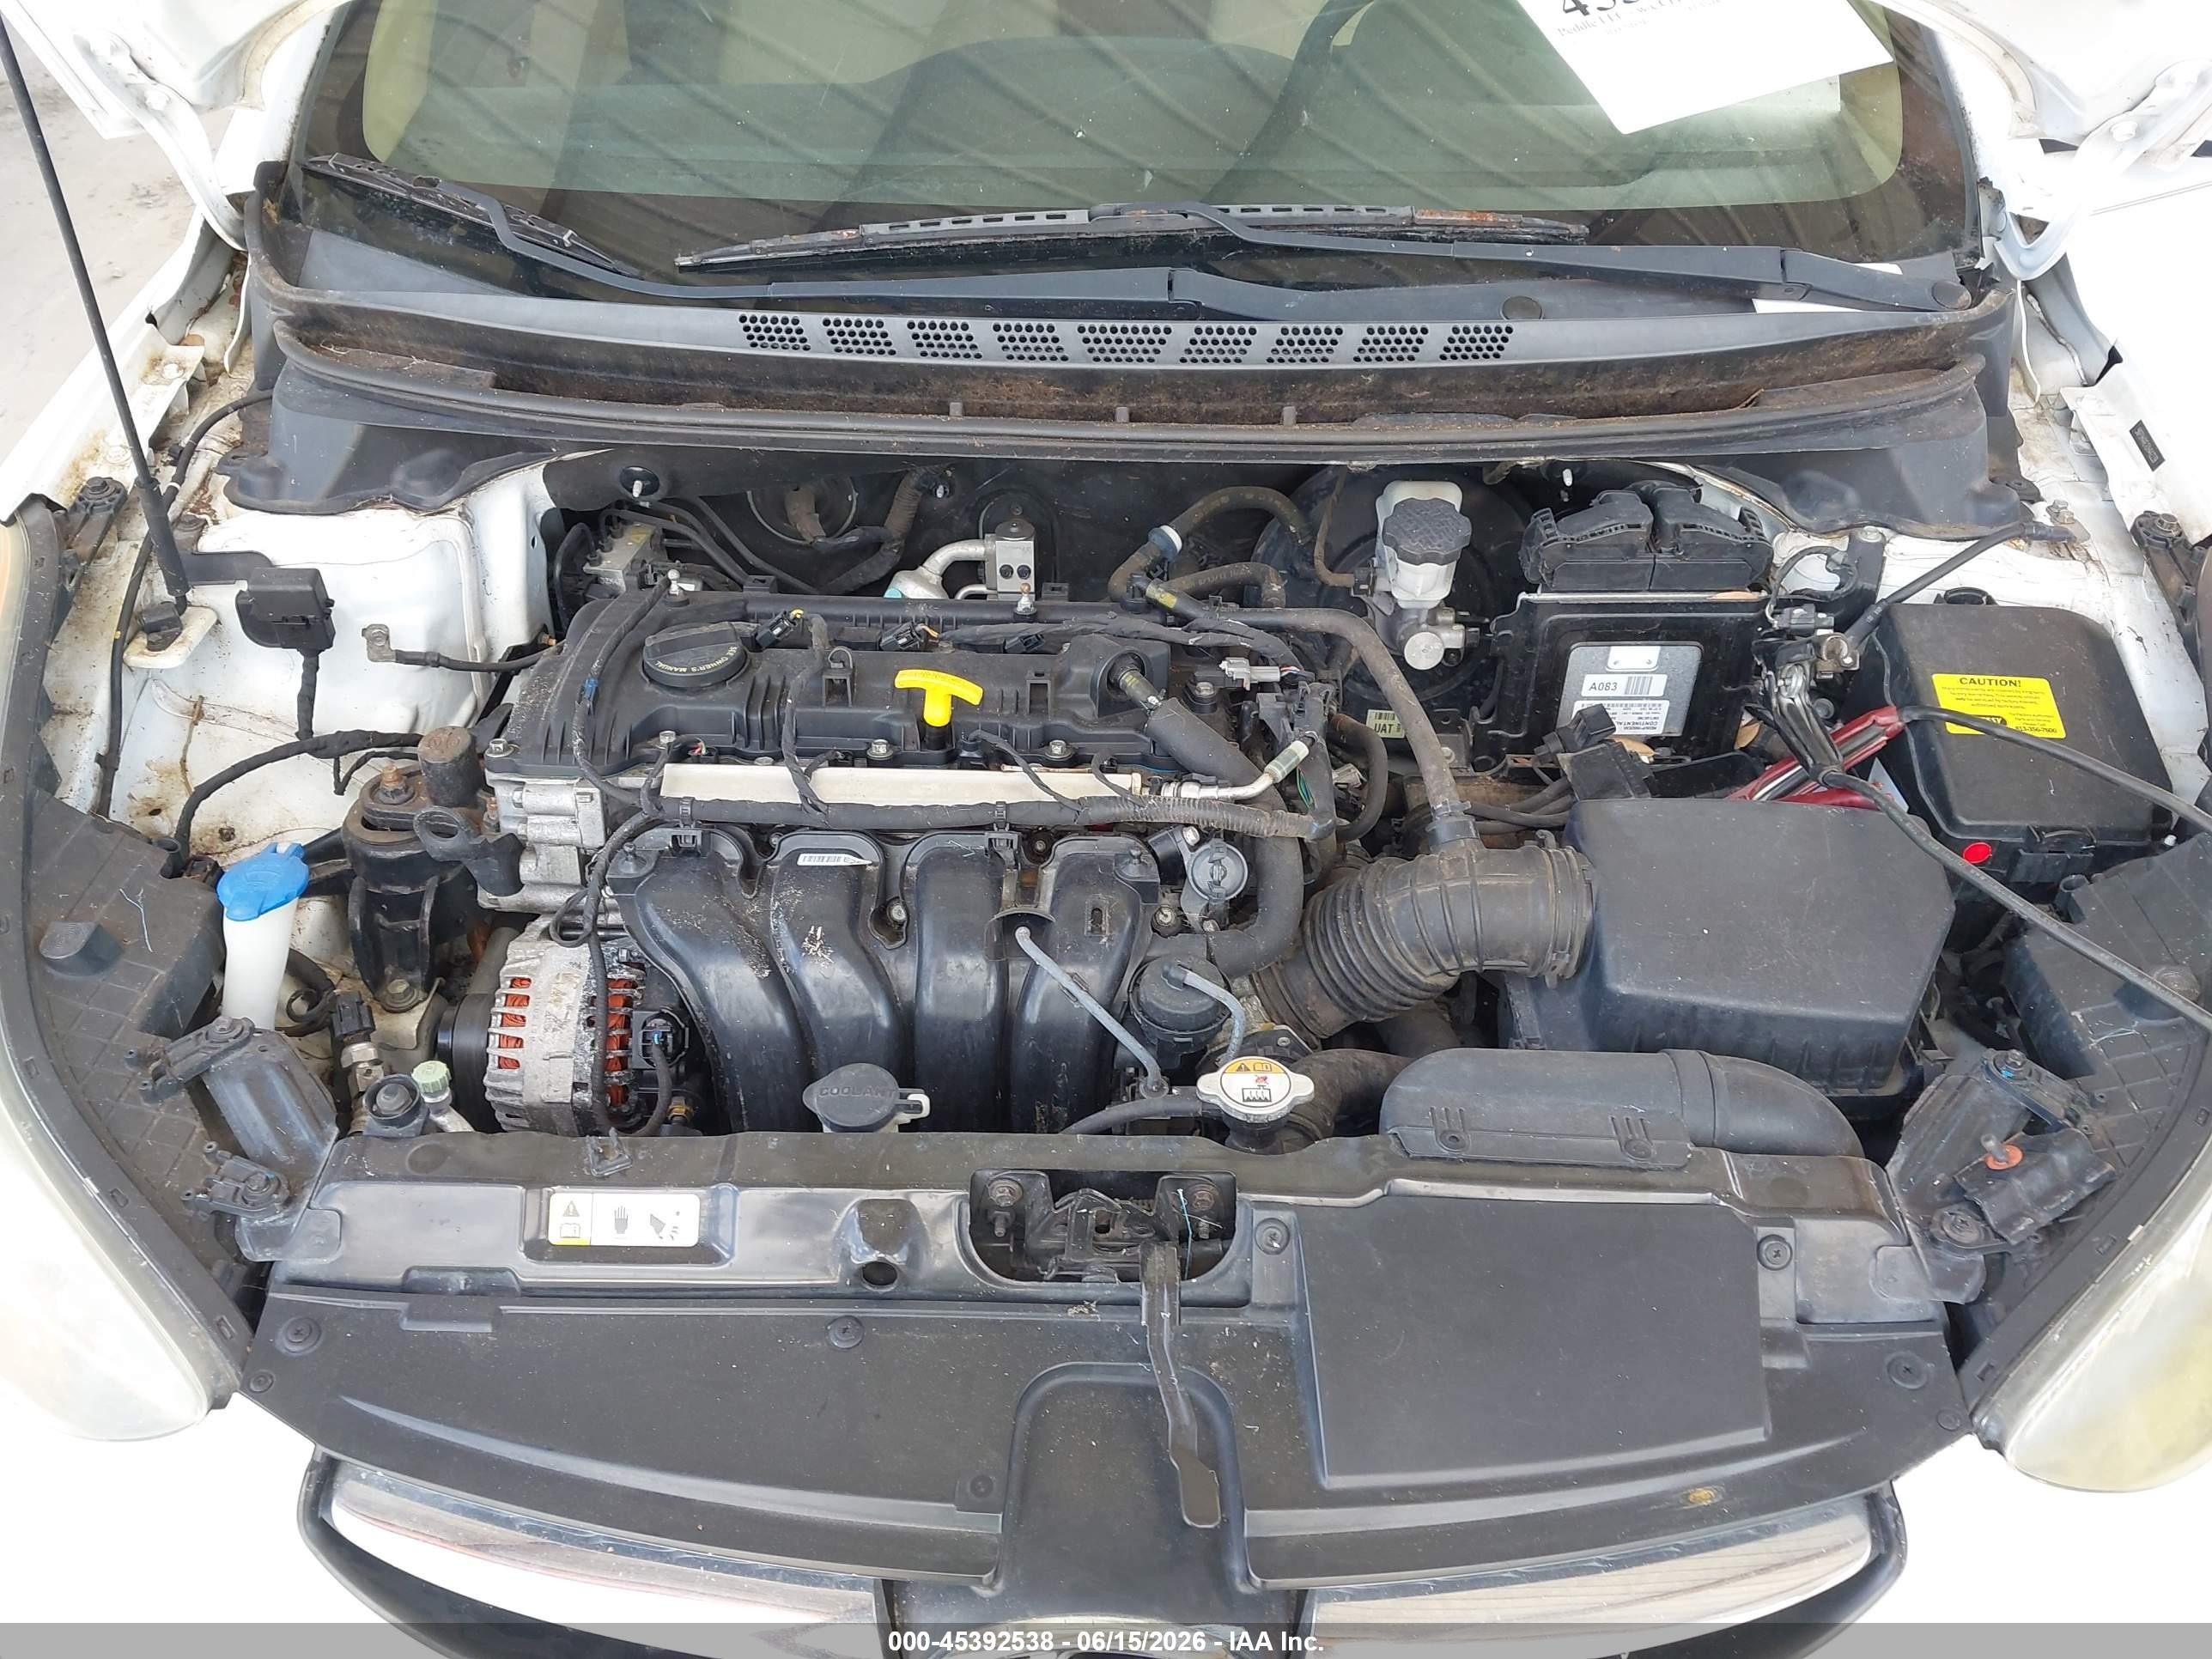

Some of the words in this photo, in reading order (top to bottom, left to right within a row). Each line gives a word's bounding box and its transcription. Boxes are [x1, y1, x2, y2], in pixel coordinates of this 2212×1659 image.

[728, 646, 738, 656] SEE
[655, 660, 688, 672] MANUAL
[691, 656, 729, 672] OWNER'S
[1589, 683, 1618, 691] A083
[1960, 678, 2021, 687] CAUTION!
[1375, 723, 1394, 733] UAT
[818, 1085, 895, 1099] COOLANT
